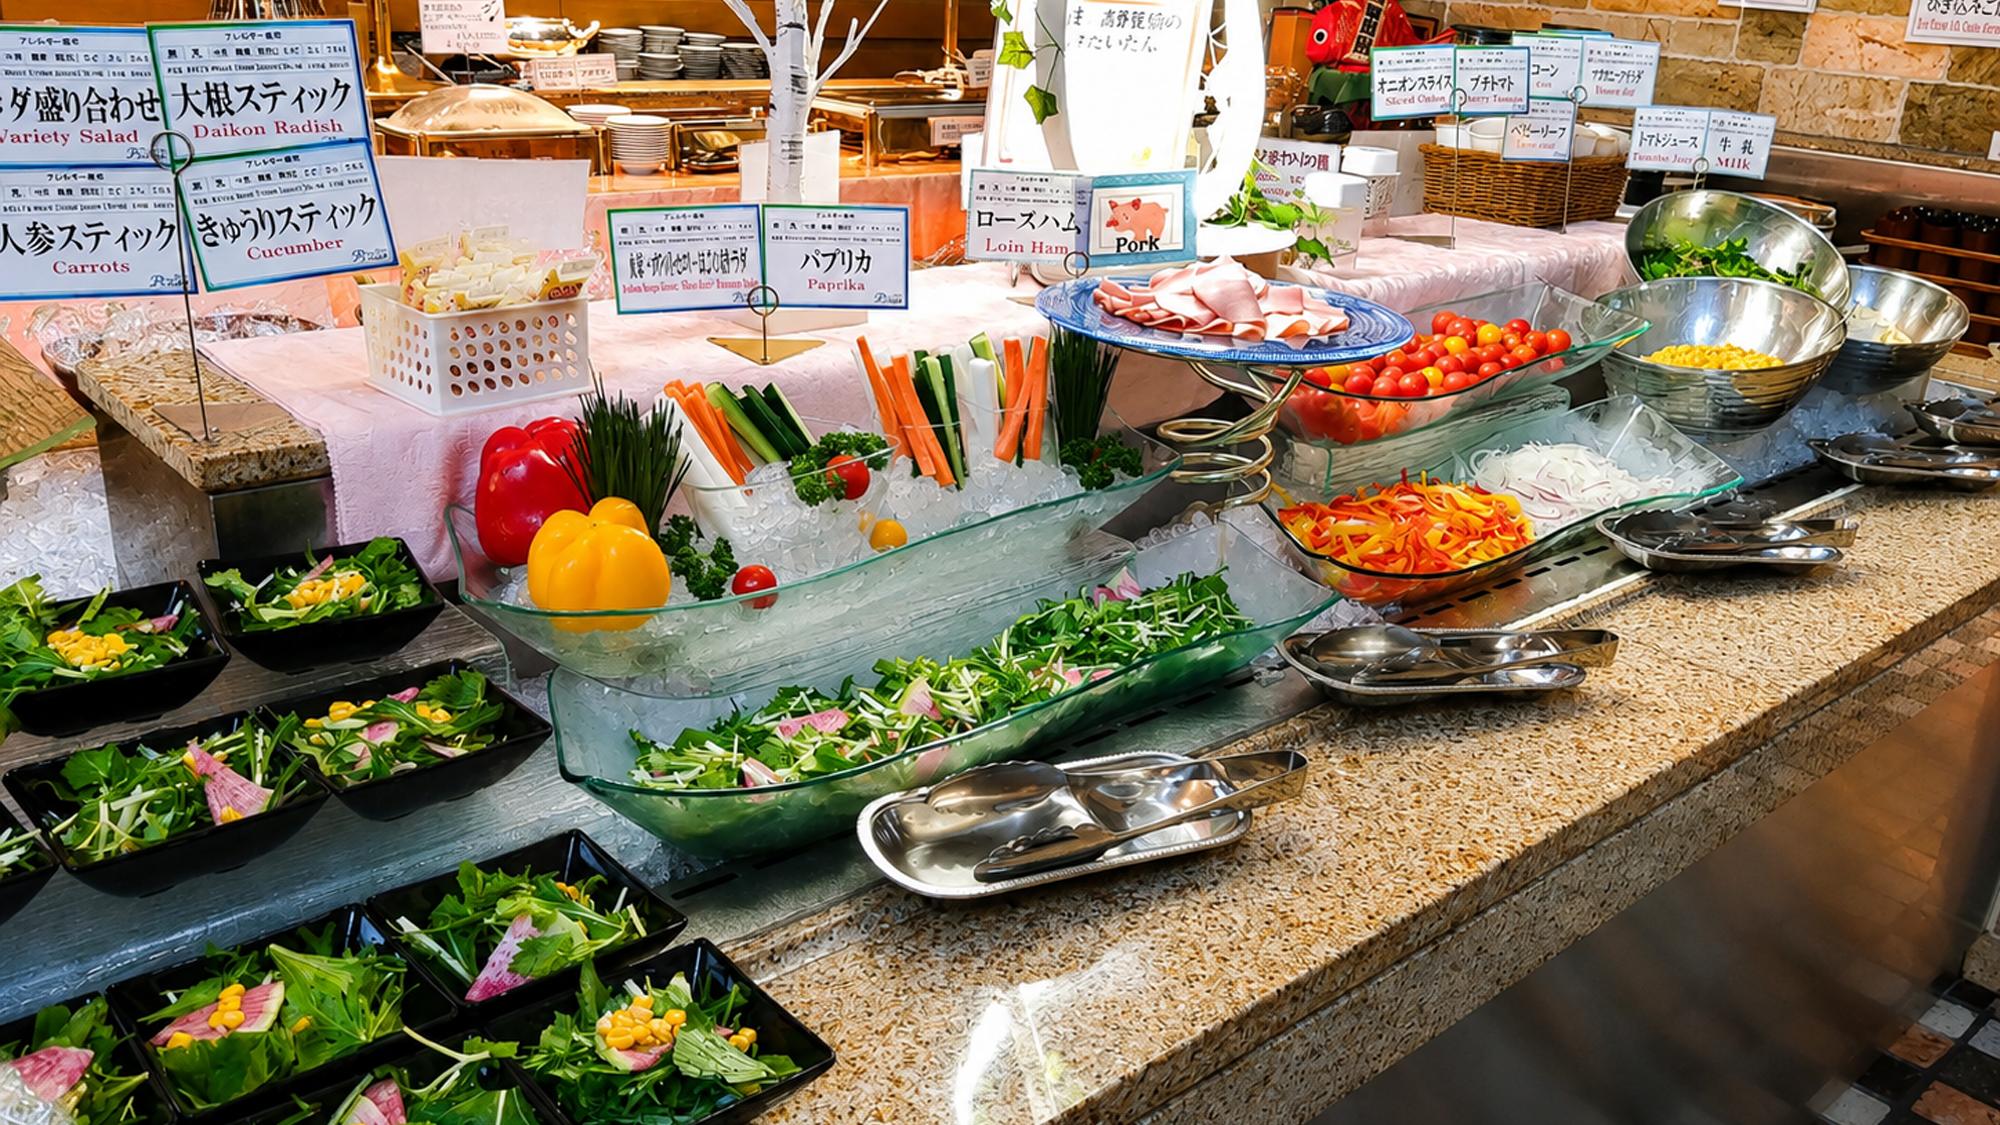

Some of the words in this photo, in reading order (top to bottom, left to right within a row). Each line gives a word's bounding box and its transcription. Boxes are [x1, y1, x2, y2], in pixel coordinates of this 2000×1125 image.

[1531, 63, 1559, 78] コーン
[1377, 73, 1453, 95] オニオンスライス
[1470, 75, 1514, 92] プチトマト
[0, 85, 161, 124] ダ盛り合わせ
[171, 77, 351, 121] 大根スティック
[0, 129, 70, 147] Variety
[80, 129, 139, 144] Salad
[194, 123, 266, 139] Daikon
[274, 118, 343, 135] Radish
[1510, 122, 1567, 138] ベビーリーフ
[1638, 131, 1698, 149] トマトジュース
[1716, 156, 1750, 170] Milk
[197, 193, 376, 248] きゅうりスティック
[976, 209, 1081, 235] ローズハム
[0, 218, 176, 256] 人参スティック
[986, 238, 1024, 253] Loin
[1032, 240, 1069, 255] Ham
[1116, 234, 1161, 253] Pork
[247, 238, 343, 261] Cucumber
[53, 260, 130, 275] Carrots
[800, 248, 871, 275] パプリカ
[808, 279, 865, 292] Paprika
